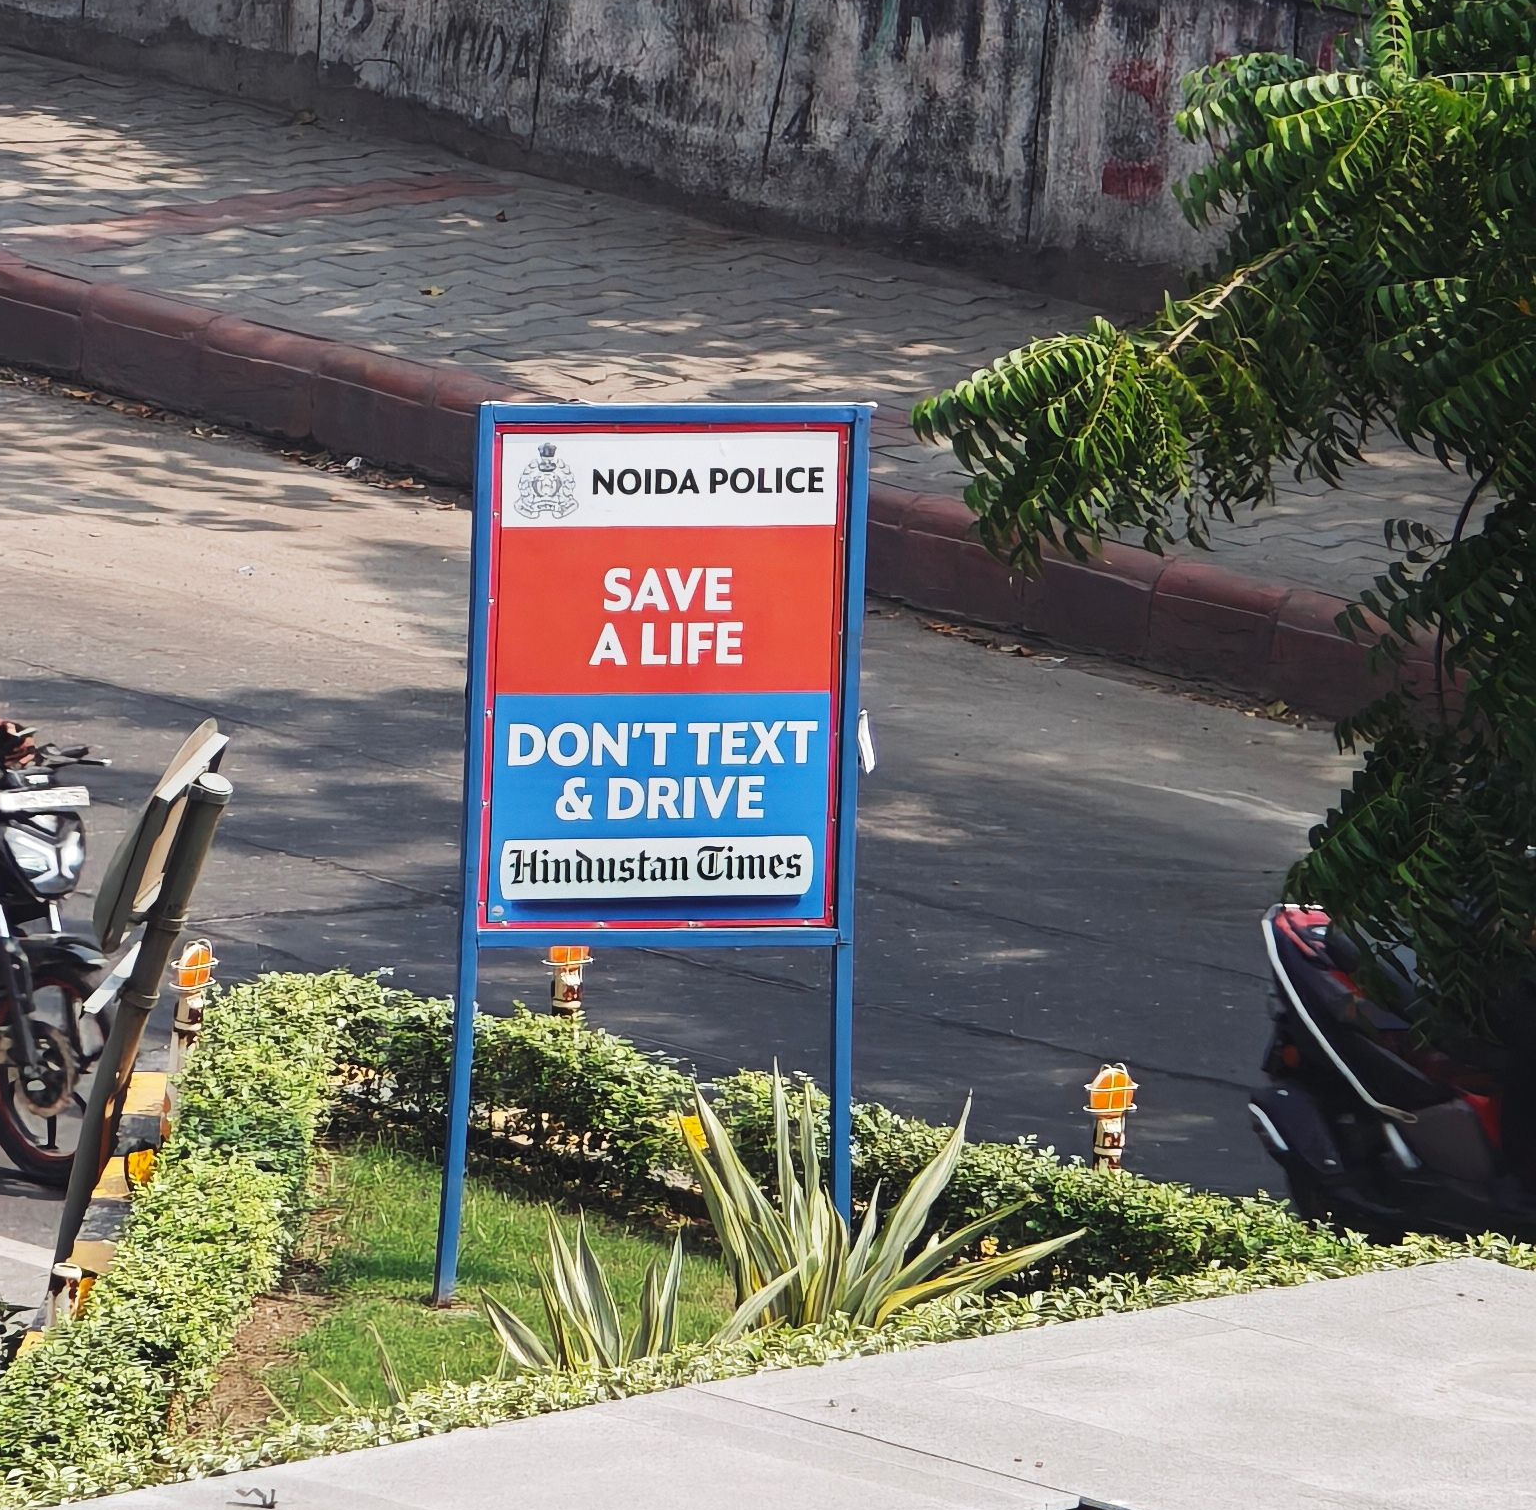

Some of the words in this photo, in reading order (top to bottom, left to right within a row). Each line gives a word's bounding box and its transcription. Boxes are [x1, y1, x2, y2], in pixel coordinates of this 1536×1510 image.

[592, 468, 700, 496] NOIDA
[709, 466, 824, 494] POLICE
[603, 567, 733, 612] SAVE
[588, 622, 627, 666] A
[640, 621, 744, 666] LIFE
[507, 722, 677, 767] DON'T
[687, 720, 819, 766] TEXT
[554, 776, 593, 821] &
[607, 775, 765, 820] DRIVE
[509, 849, 690, 885] Hindustan
[696, 845, 802, 882] Times
